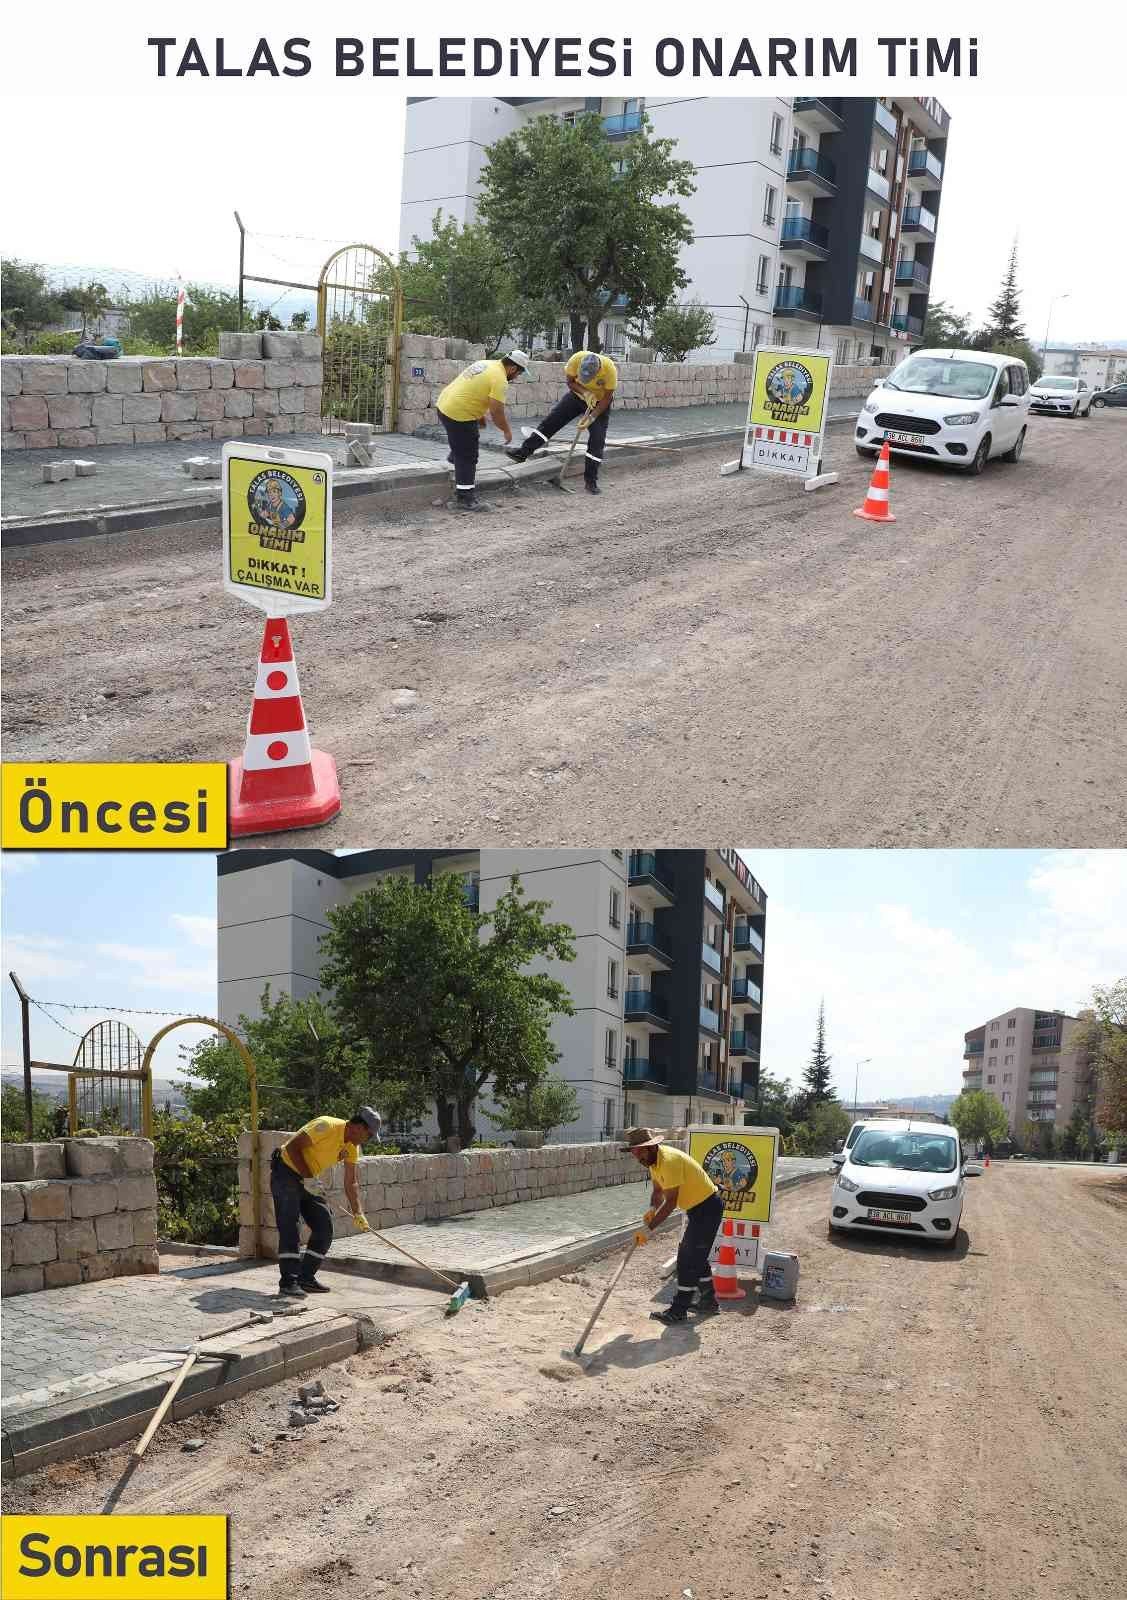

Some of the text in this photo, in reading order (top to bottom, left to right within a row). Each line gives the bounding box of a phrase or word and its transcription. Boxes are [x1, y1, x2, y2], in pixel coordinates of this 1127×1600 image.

[764, 400, 810, 415] ONARIM
[249, 473, 267, 493] TALAS
[248, 522, 305, 543] ONARIM
[294, 580, 320, 595] VAR
